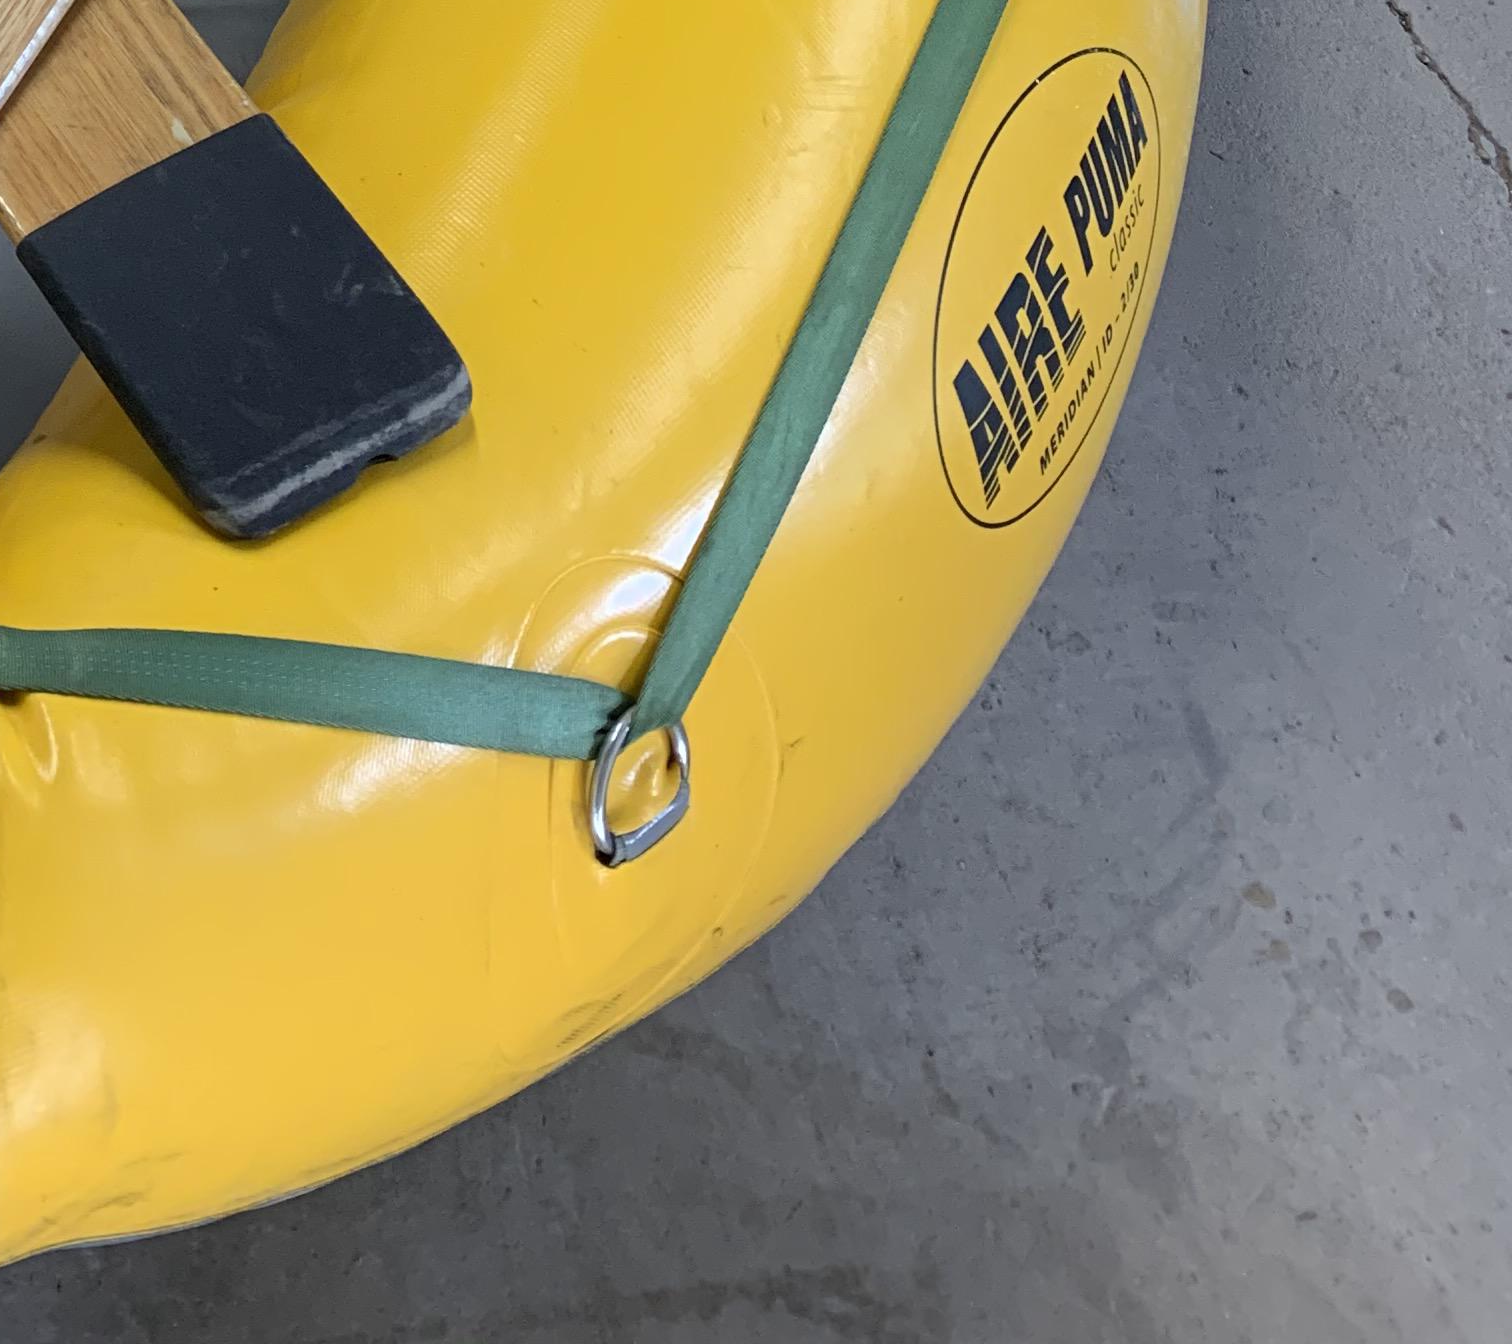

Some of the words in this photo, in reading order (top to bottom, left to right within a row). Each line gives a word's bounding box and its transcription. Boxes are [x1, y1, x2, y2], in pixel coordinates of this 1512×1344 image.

[952, 225, 1086, 510] AIRE
[1063, 69, 1148, 277] PUMA
[1109, 183, 1145, 272] classic
[1039, 360, 1095, 475] MERIDIAN
[1102, 324, 1113, 355] ID
